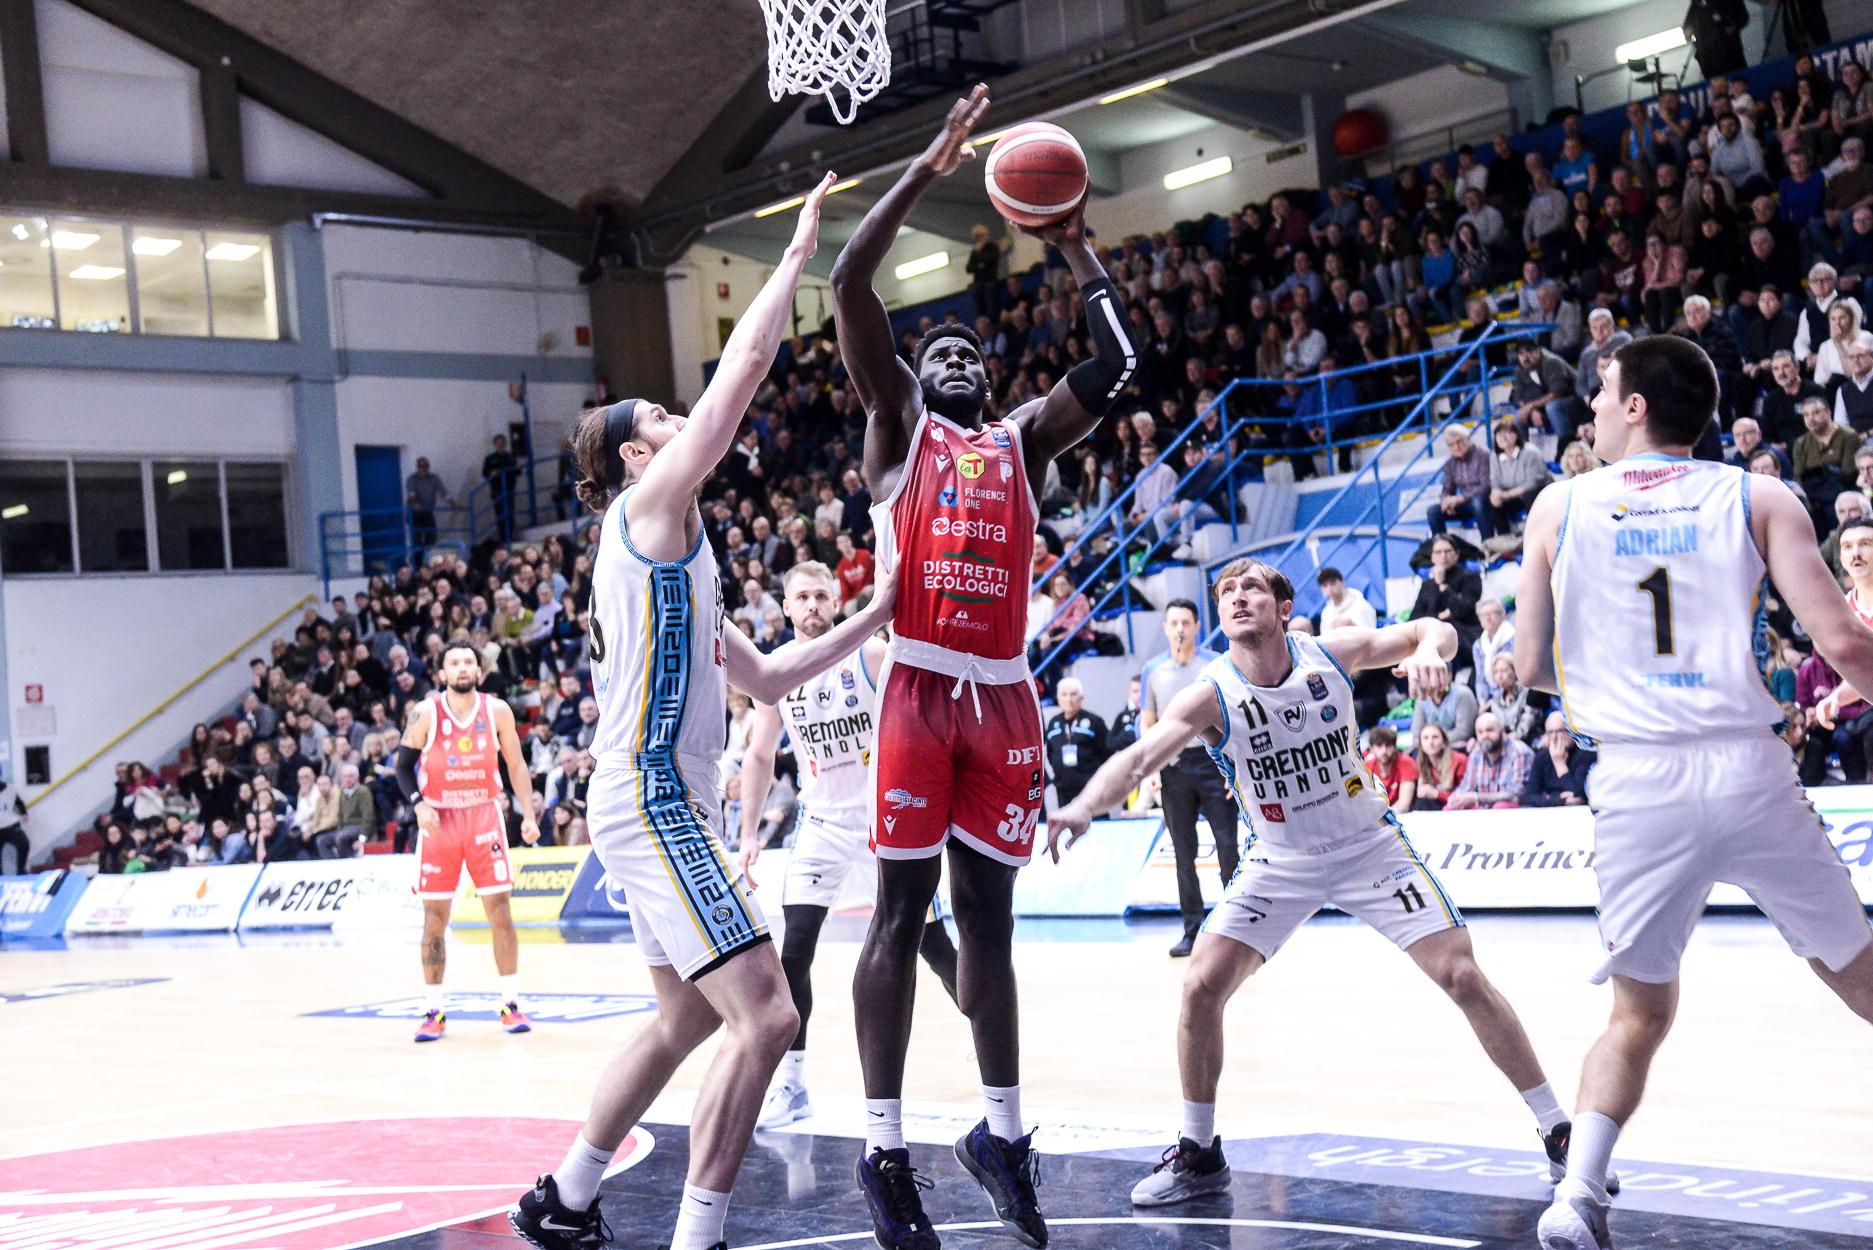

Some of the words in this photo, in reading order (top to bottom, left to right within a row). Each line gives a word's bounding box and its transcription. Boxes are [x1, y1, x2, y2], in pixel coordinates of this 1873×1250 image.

[964, 487, 1006, 501] FLORENCE
[964, 500, 981, 509] ONE
[951, 518, 1007, 543] estra
[1615, 525, 1698, 556] ADRIAN
[923, 560, 1009, 581] DISTRETTI
[924, 575, 1007, 598] ECOLOGICI
[1636, 565, 1676, 657] 1
[797, 712, 873, 744] REMONA
[1238, 696, 1270, 730] 11
[997, 803, 1041, 845] 34
[1392, 881, 1427, 913] 11
